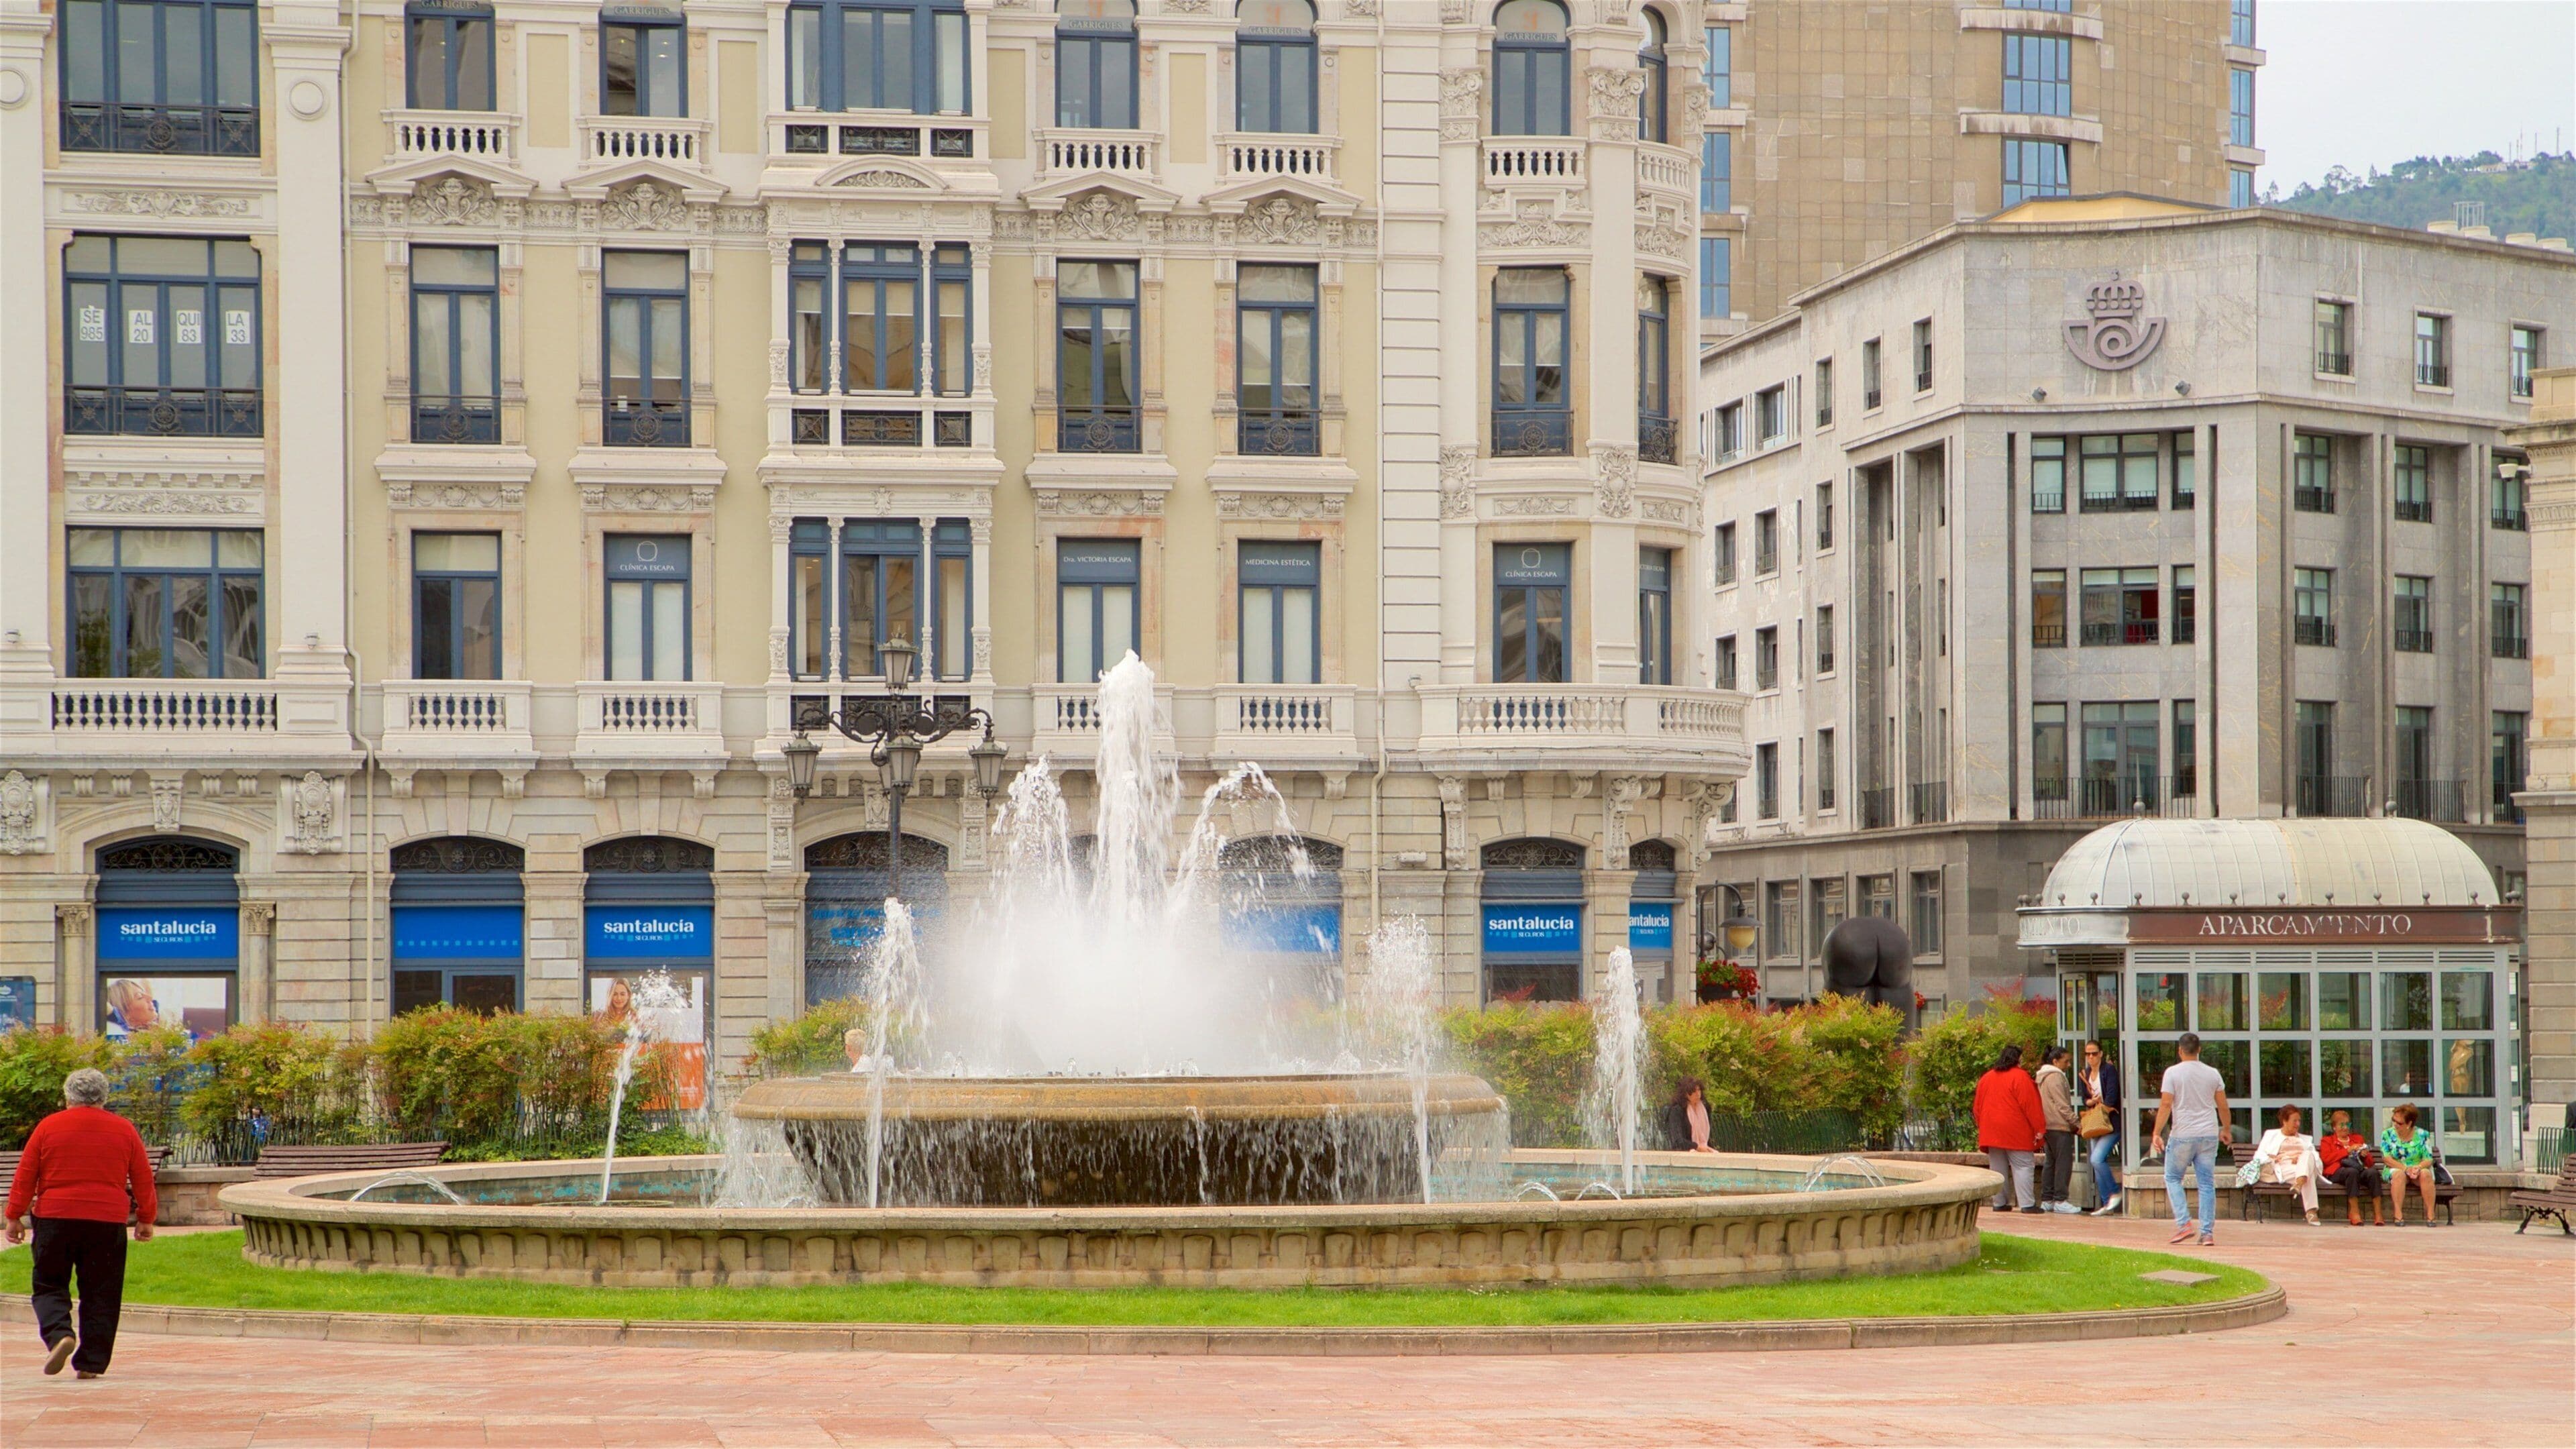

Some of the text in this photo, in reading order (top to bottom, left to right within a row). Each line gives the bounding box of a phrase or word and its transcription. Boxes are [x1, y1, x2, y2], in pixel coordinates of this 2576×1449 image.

[421, 0, 478, 8] GARRIGUES
[614, 6, 671, 15] GARRIGUES
[1069, 20, 1123, 29] GARRIGUES
[1249, 27, 1301, 35] GARRIGUES
[1504, 32, 1557, 40] GARRIGUES
[83, 310, 101, 323] SE
[135, 313, 152, 325] AL
[178, 313, 201, 325] QUI
[227, 313, 244, 326] LA
[81, 327, 103, 339] 985
[134, 329, 148, 341] 20
[182, 329, 197, 341] 83
[231, 329, 246, 342] 33
[1281, 558, 1311, 566] ESTÉTICA
[604, 919, 695, 933] santalucía
[1489, 916, 1574, 930] santalucía
[1629, 914, 1670, 927] antalucía
[120, 920, 217, 934] santalucía
